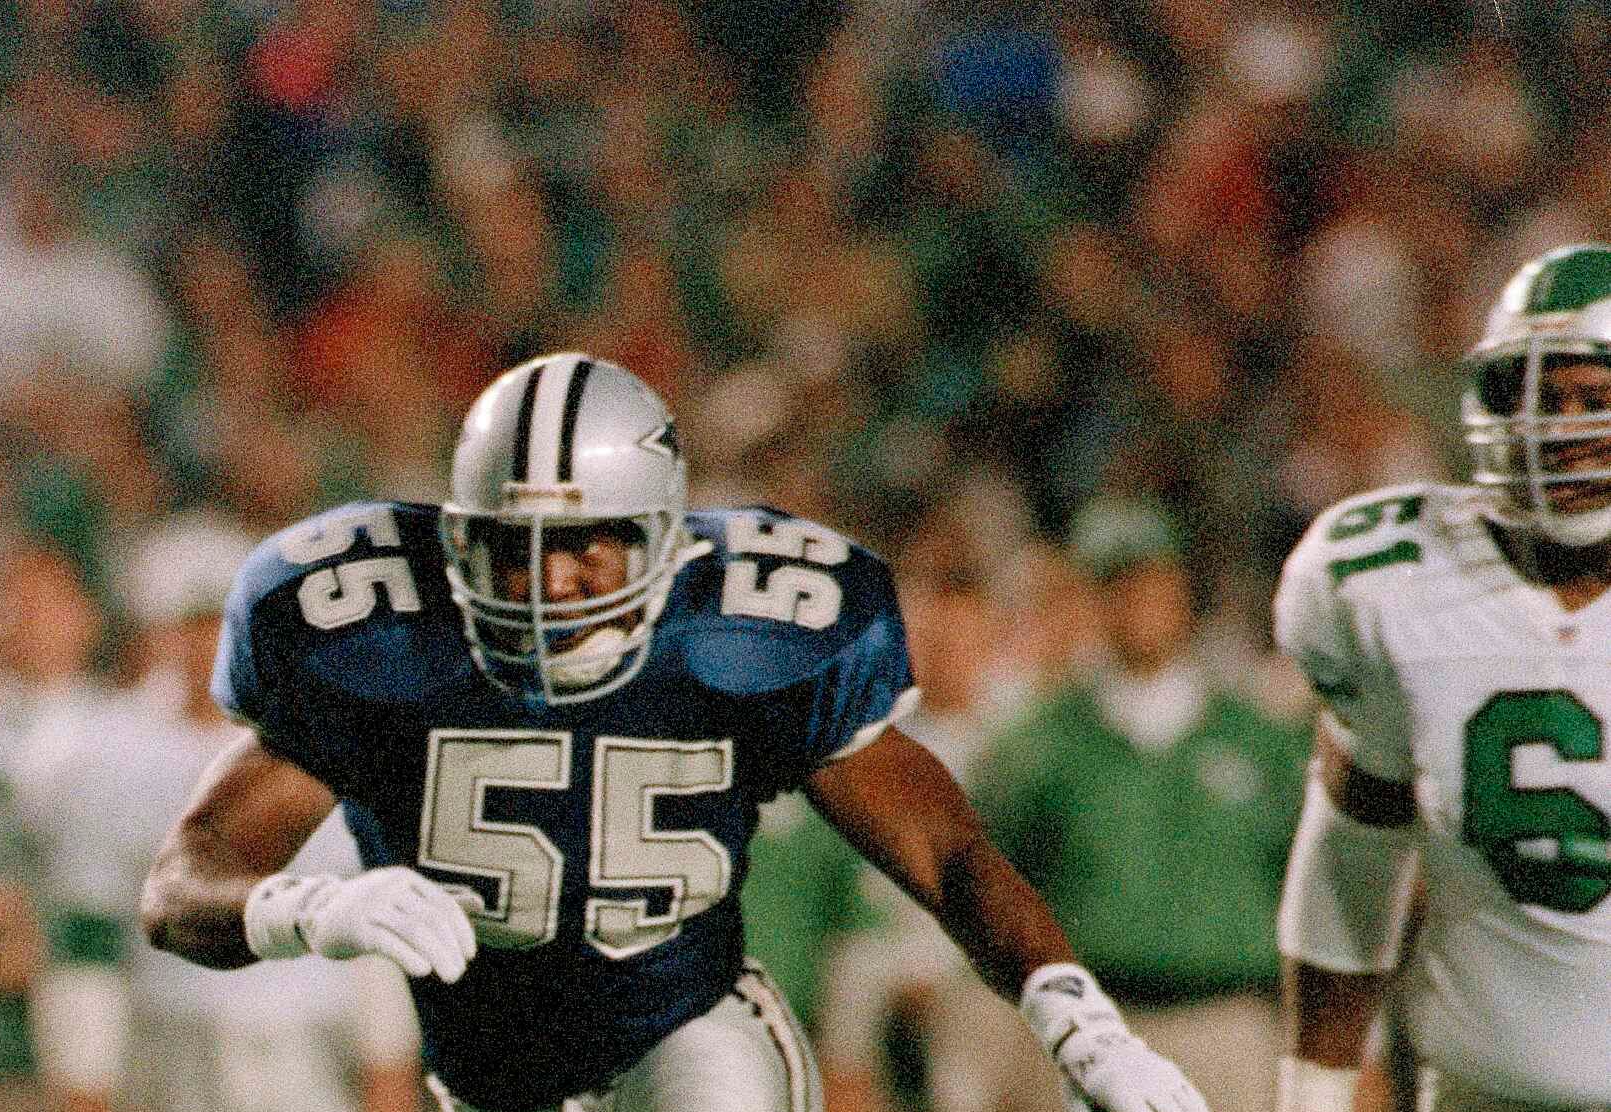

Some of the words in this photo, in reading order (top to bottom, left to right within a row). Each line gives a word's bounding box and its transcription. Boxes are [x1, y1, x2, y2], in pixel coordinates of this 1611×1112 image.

[280, 511, 421, 630] 55
[720, 510, 849, 630] 55
[417, 728, 733, 960] 55
